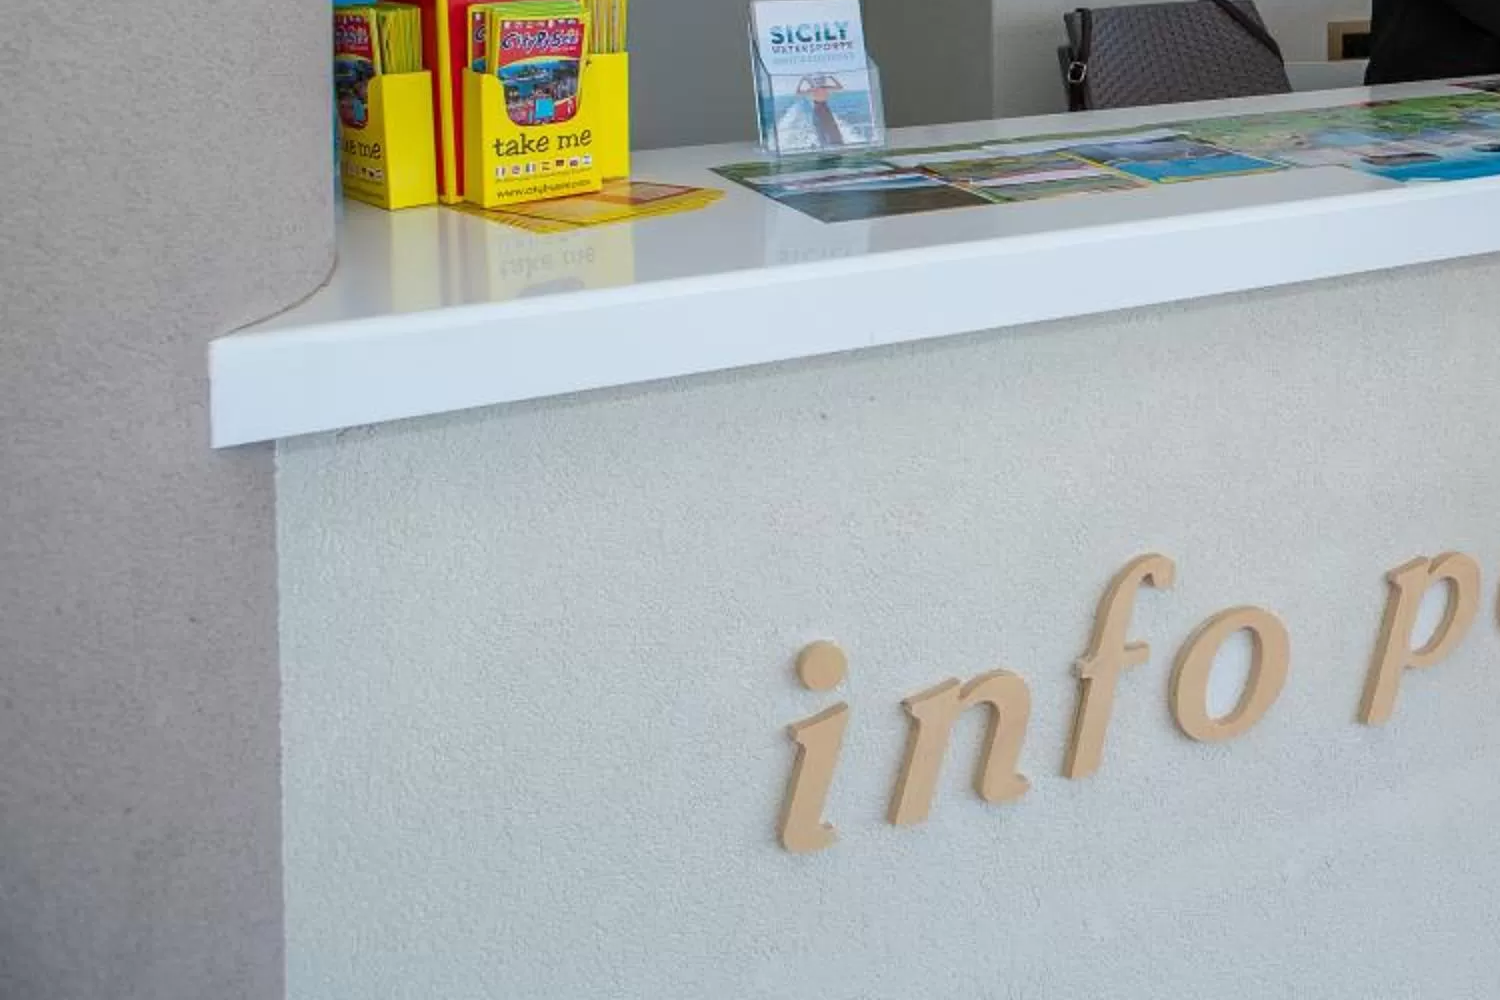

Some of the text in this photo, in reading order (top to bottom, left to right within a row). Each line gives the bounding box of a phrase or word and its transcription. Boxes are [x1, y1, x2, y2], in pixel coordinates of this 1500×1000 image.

[770, 21, 849, 45] SICILY
[771, 40, 854, 54] WATERSPORTS
[492, 129, 592, 157] take me
[775, 553, 1291, 853] info
